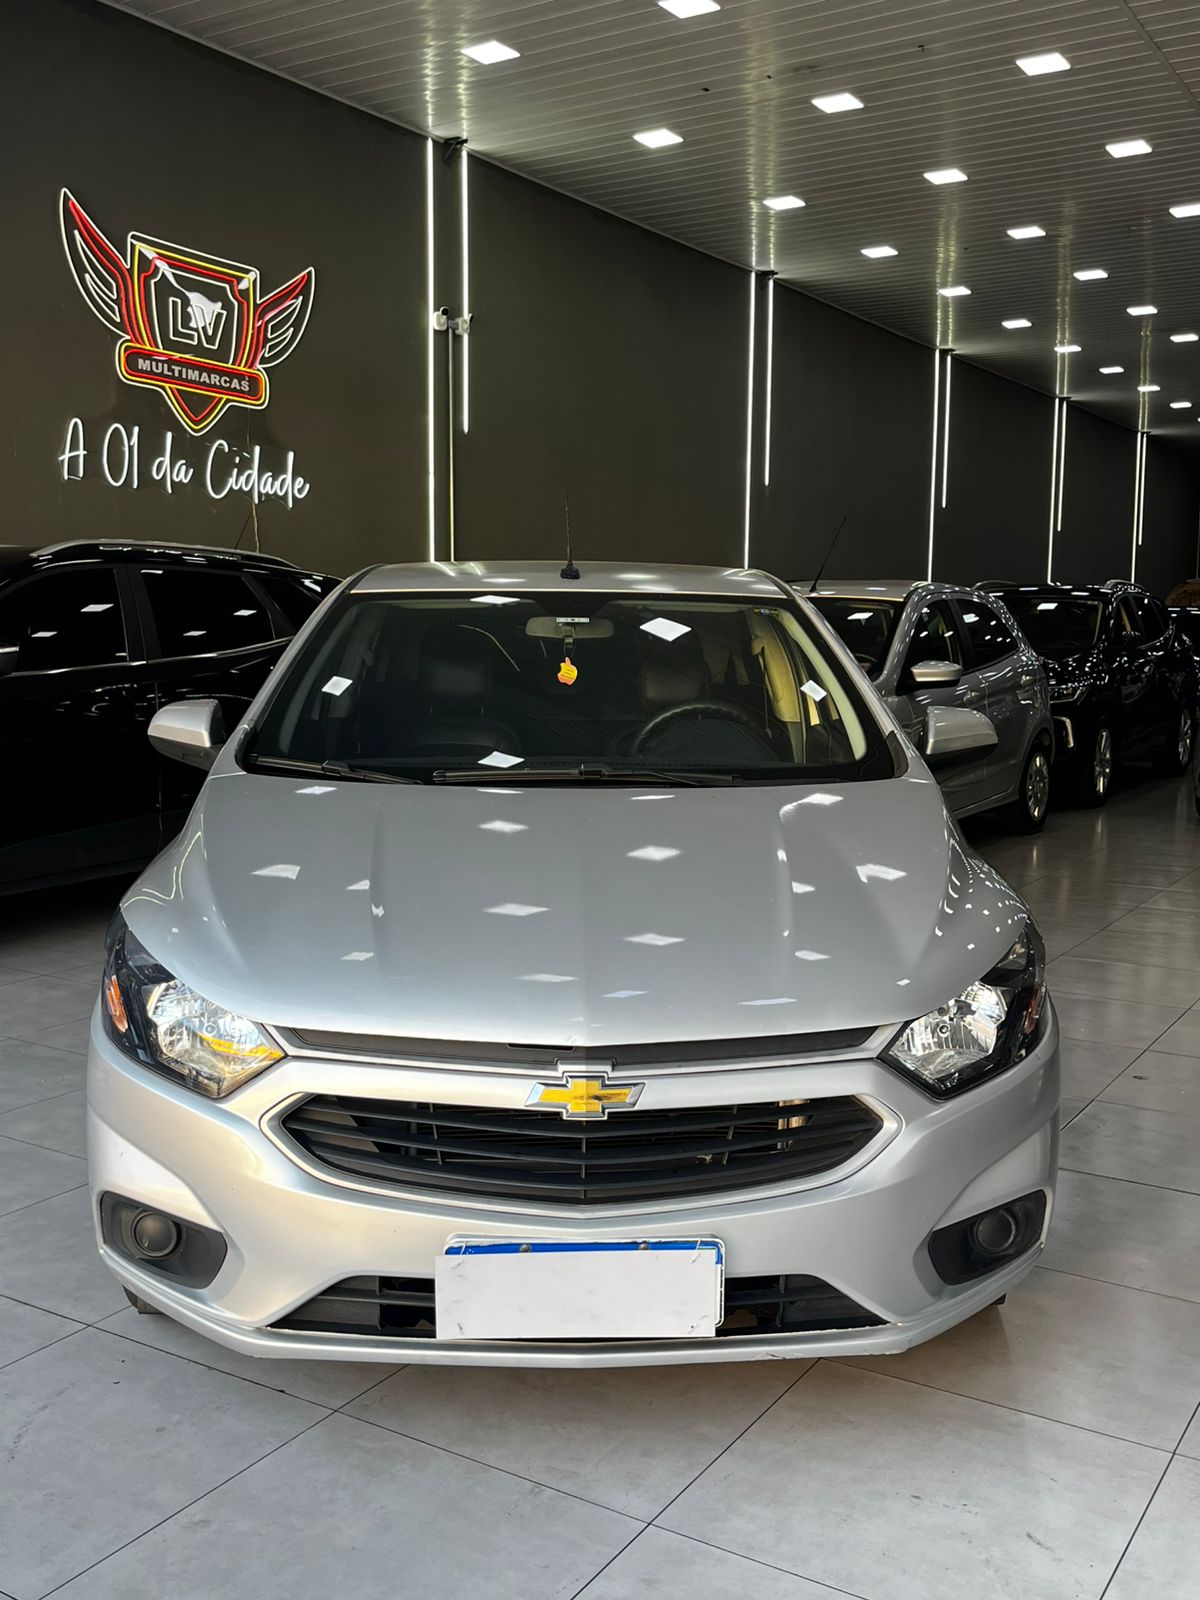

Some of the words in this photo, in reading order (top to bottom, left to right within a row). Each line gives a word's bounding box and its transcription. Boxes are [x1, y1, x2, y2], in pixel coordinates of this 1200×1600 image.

[168, 297, 227, 349] LV
[137, 358, 250, 392] MULTIMARCAS
[58, 417, 88, 480] A
[152, 431, 193, 494] da
[206, 439, 310, 508] Cidade
